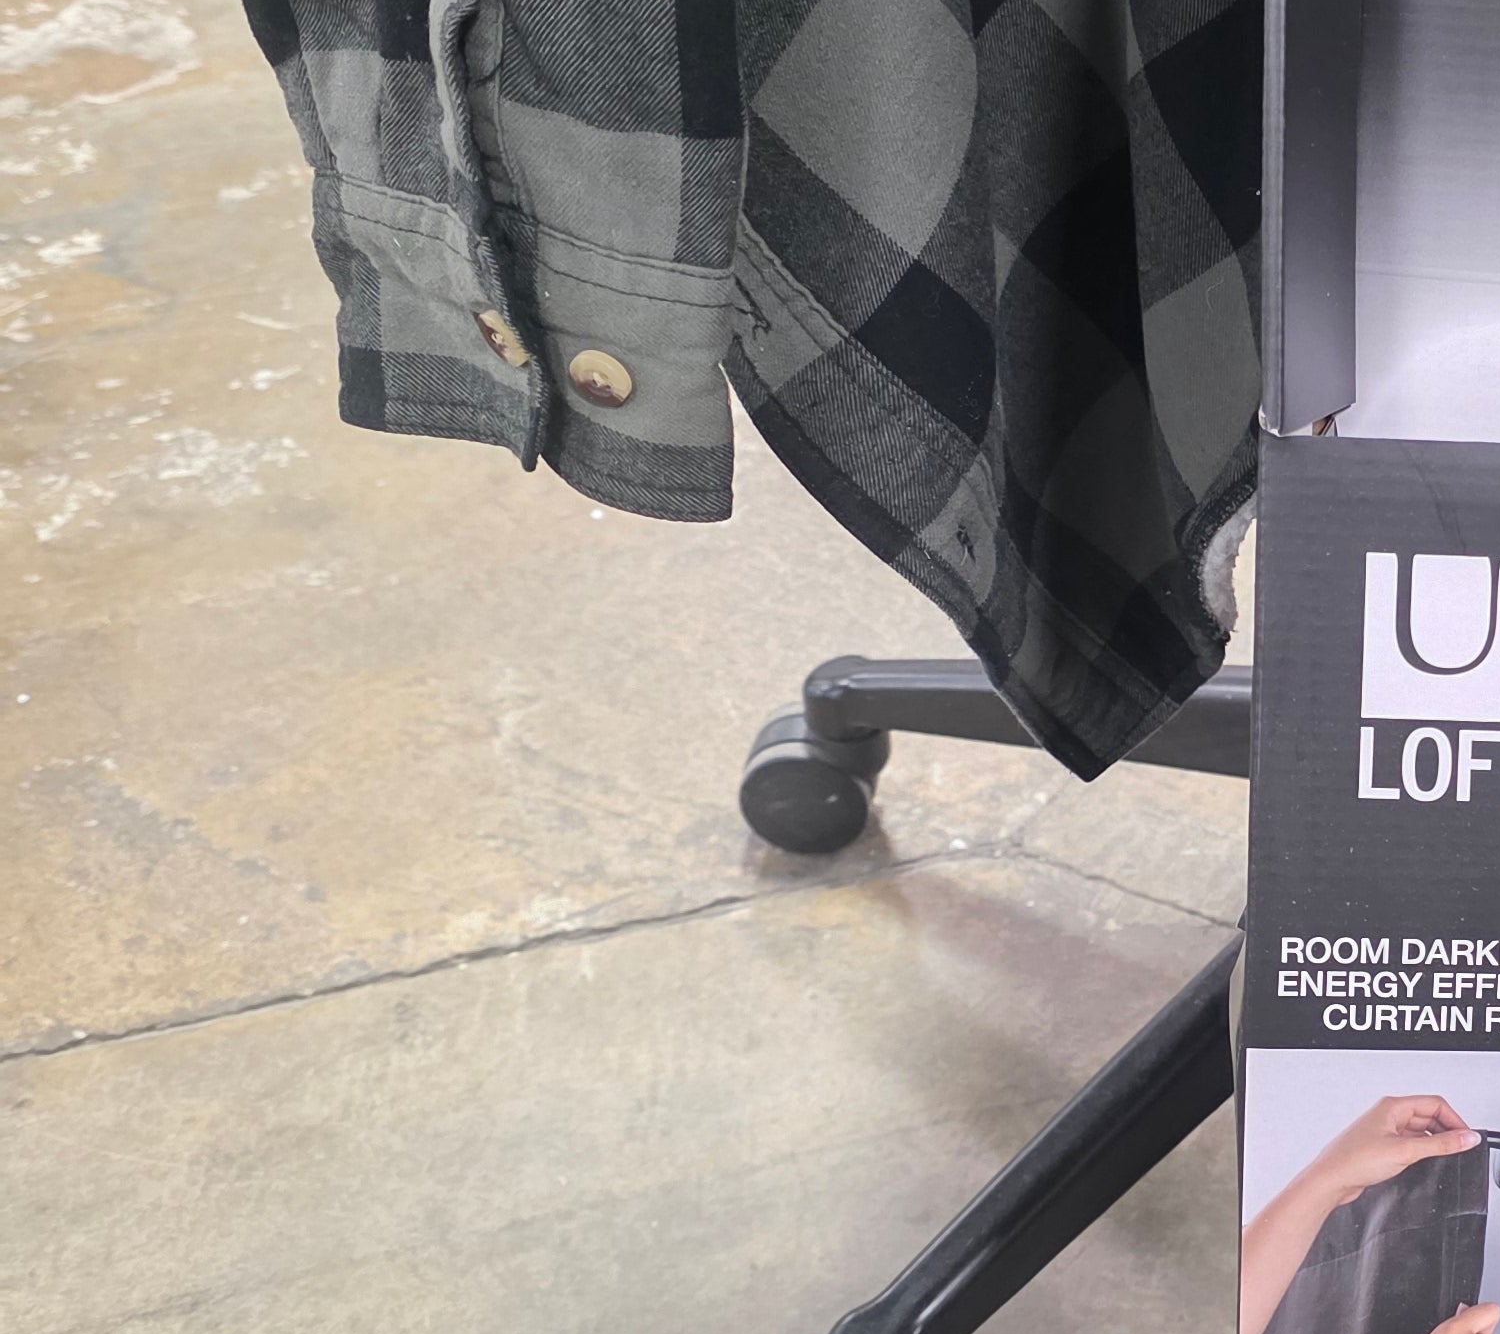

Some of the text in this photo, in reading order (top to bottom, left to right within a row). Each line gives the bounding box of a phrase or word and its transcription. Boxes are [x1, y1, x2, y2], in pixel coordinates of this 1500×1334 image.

[1281, 937, 1389, 964] ROOM
[1278, 971, 1422, 998] ENERGY
[1323, 1004, 1473, 1031] CURTAIN
